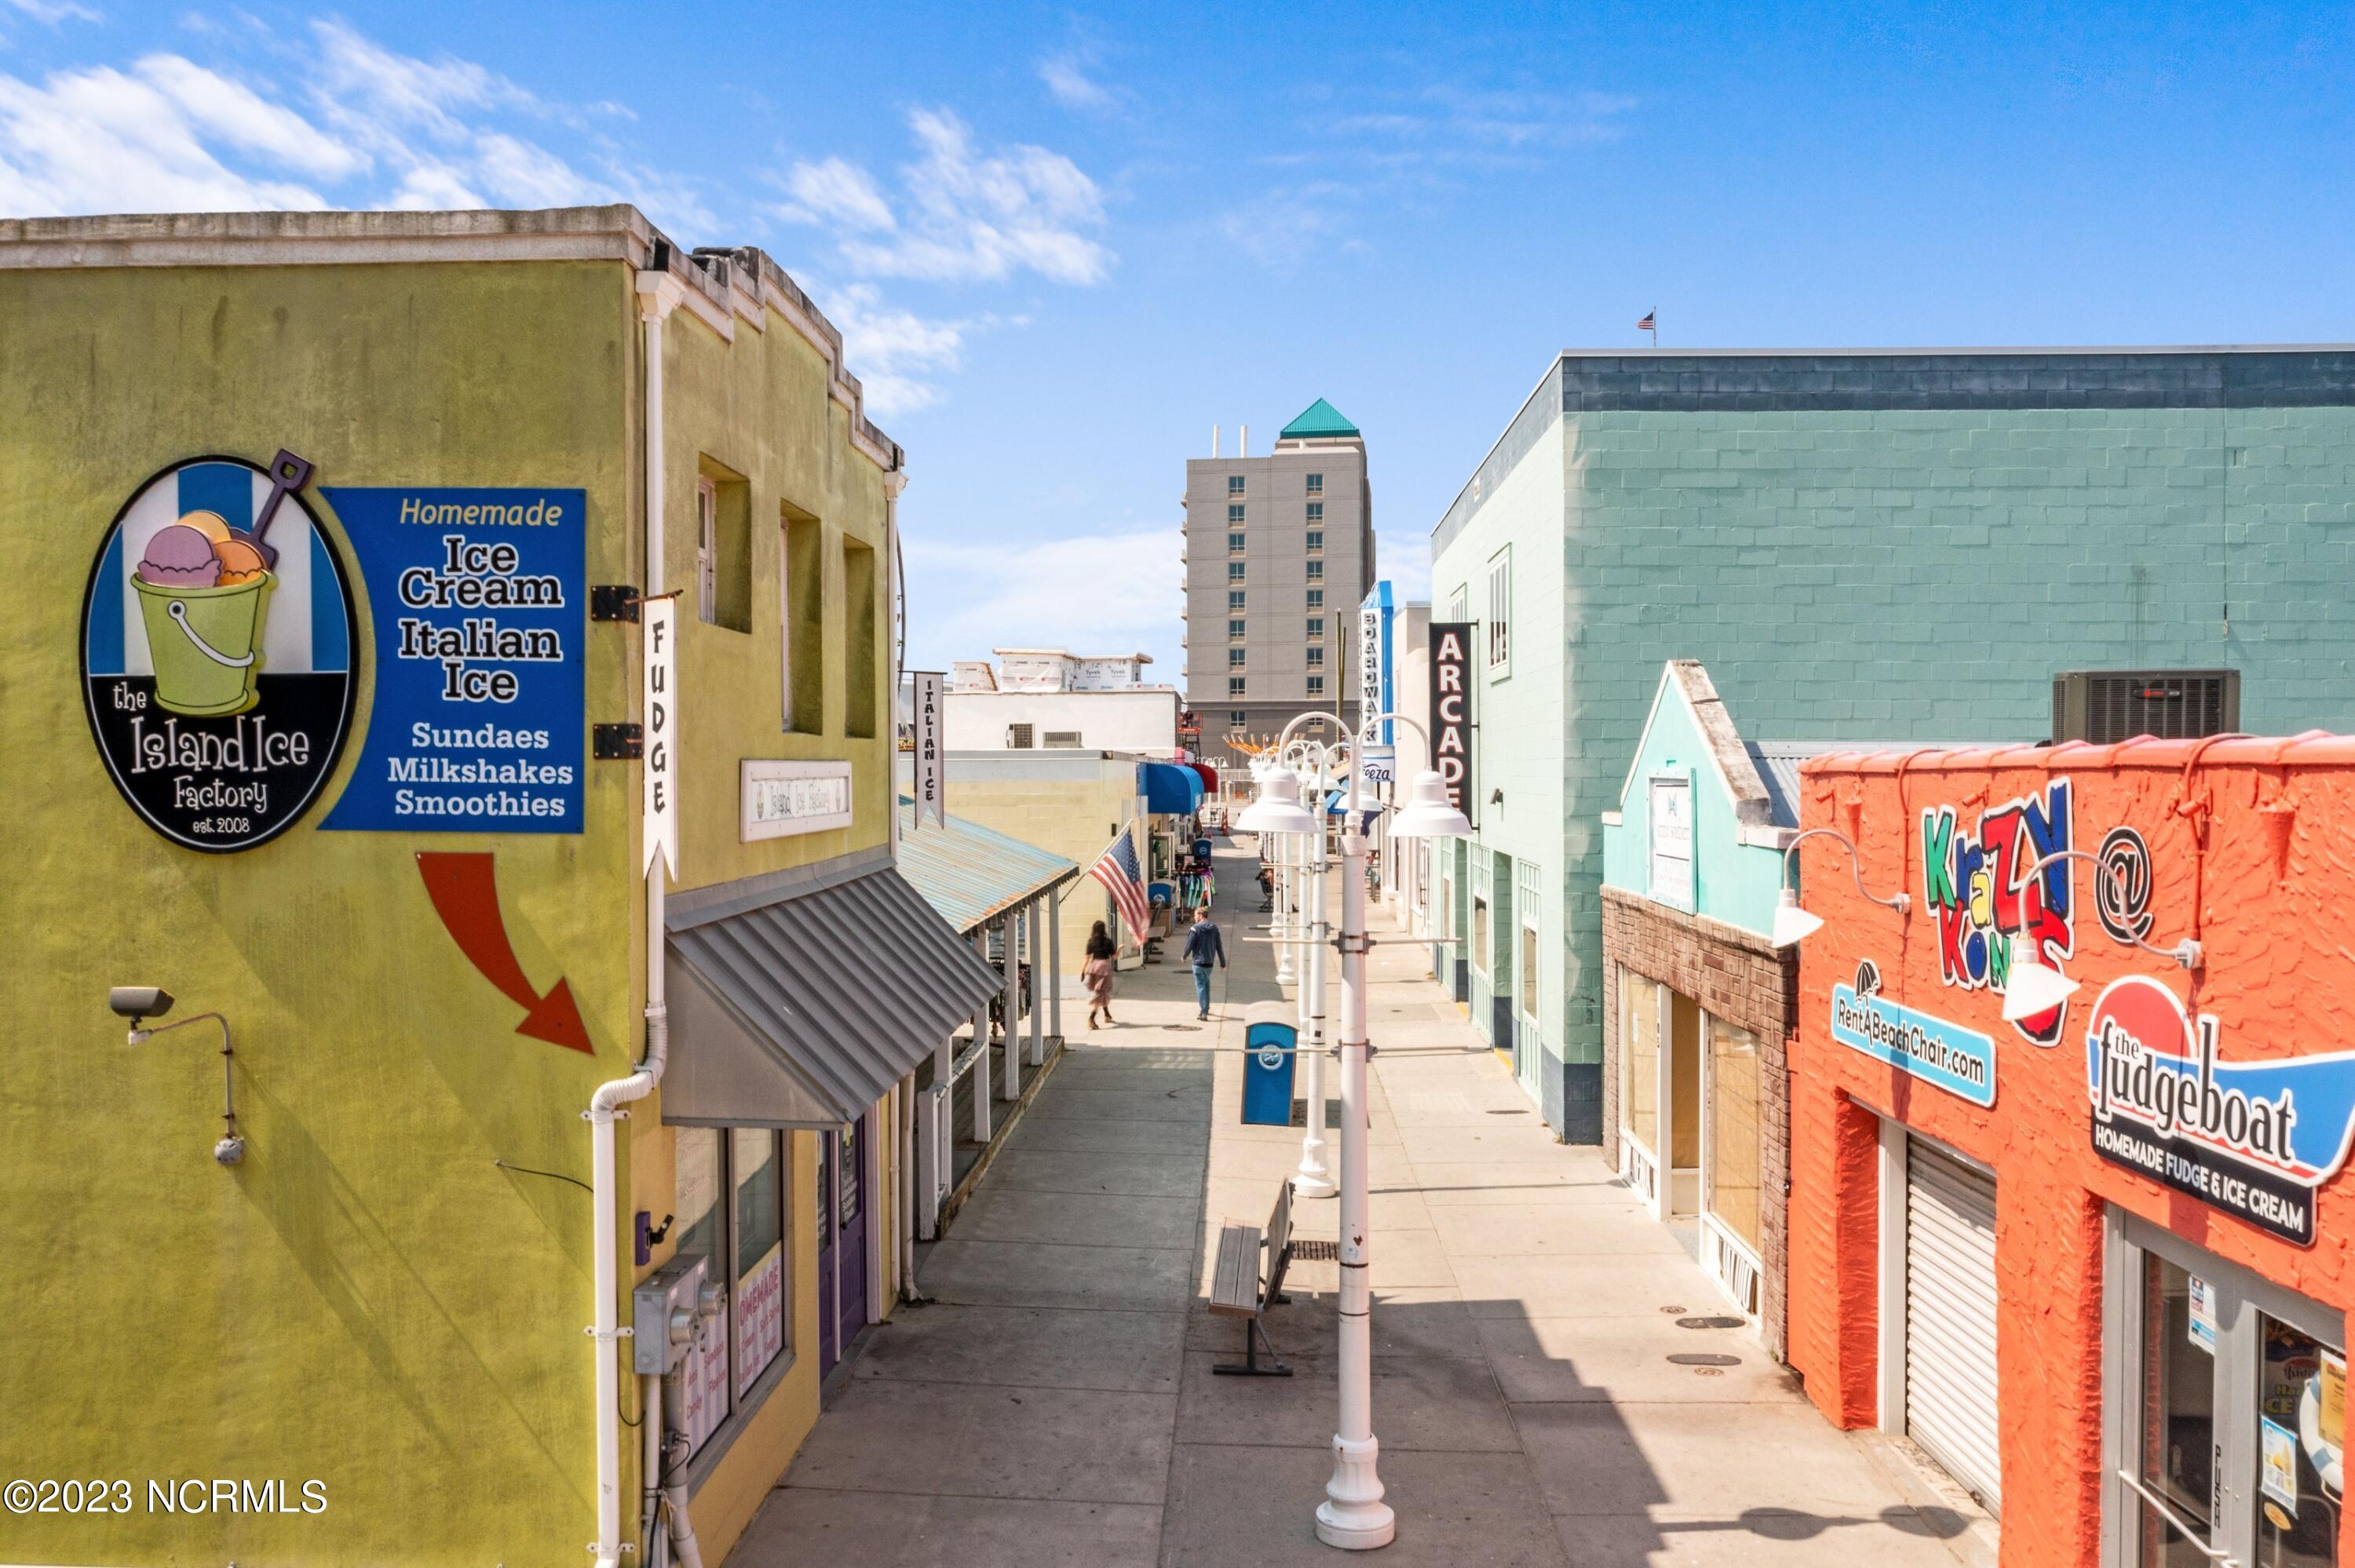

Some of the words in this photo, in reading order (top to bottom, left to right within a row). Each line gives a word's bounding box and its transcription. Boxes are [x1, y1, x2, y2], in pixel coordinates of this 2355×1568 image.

[400, 498, 563, 527] Homemade
[444, 536, 518, 574] Ice
[399, 567, 564, 607] Cream
[399, 619, 564, 662] Italian
[112, 681, 147, 709] the
[443, 659, 518, 703] Ice
[412, 722, 550, 749] Sundaes
[651, 620, 666, 815] FUDGE
[924, 680, 935, 760] ITALIAN
[1437, 633, 1464, 811] ARCADE
[130, 715, 249, 774] Island
[253, 715, 310, 773] Ice
[388, 757, 573, 785] Milkshakes
[924, 767, 934, 801] ICE
[173, 775, 268, 813] Factory
[394, 789, 565, 817] Smoothies
[192, 818, 216, 834] est.
[217, 818, 251, 834] 2008
[1838, 997, 1984, 1084] RentABeachChair.com
[2115, 1034, 2140, 1059] the
[2098, 1020, 2293, 1162] fudgeboat
[2095, 1125, 2164, 1176] HOMEMADE
[2165, 1151, 2208, 1194] FUDGE
[2210, 1172, 2222, 1197] &
[2223, 1175, 2247, 1209] ICE
[2248, 1187, 2305, 1234] CREAM
[739, 1264, 779, 1327] OMEMADE
